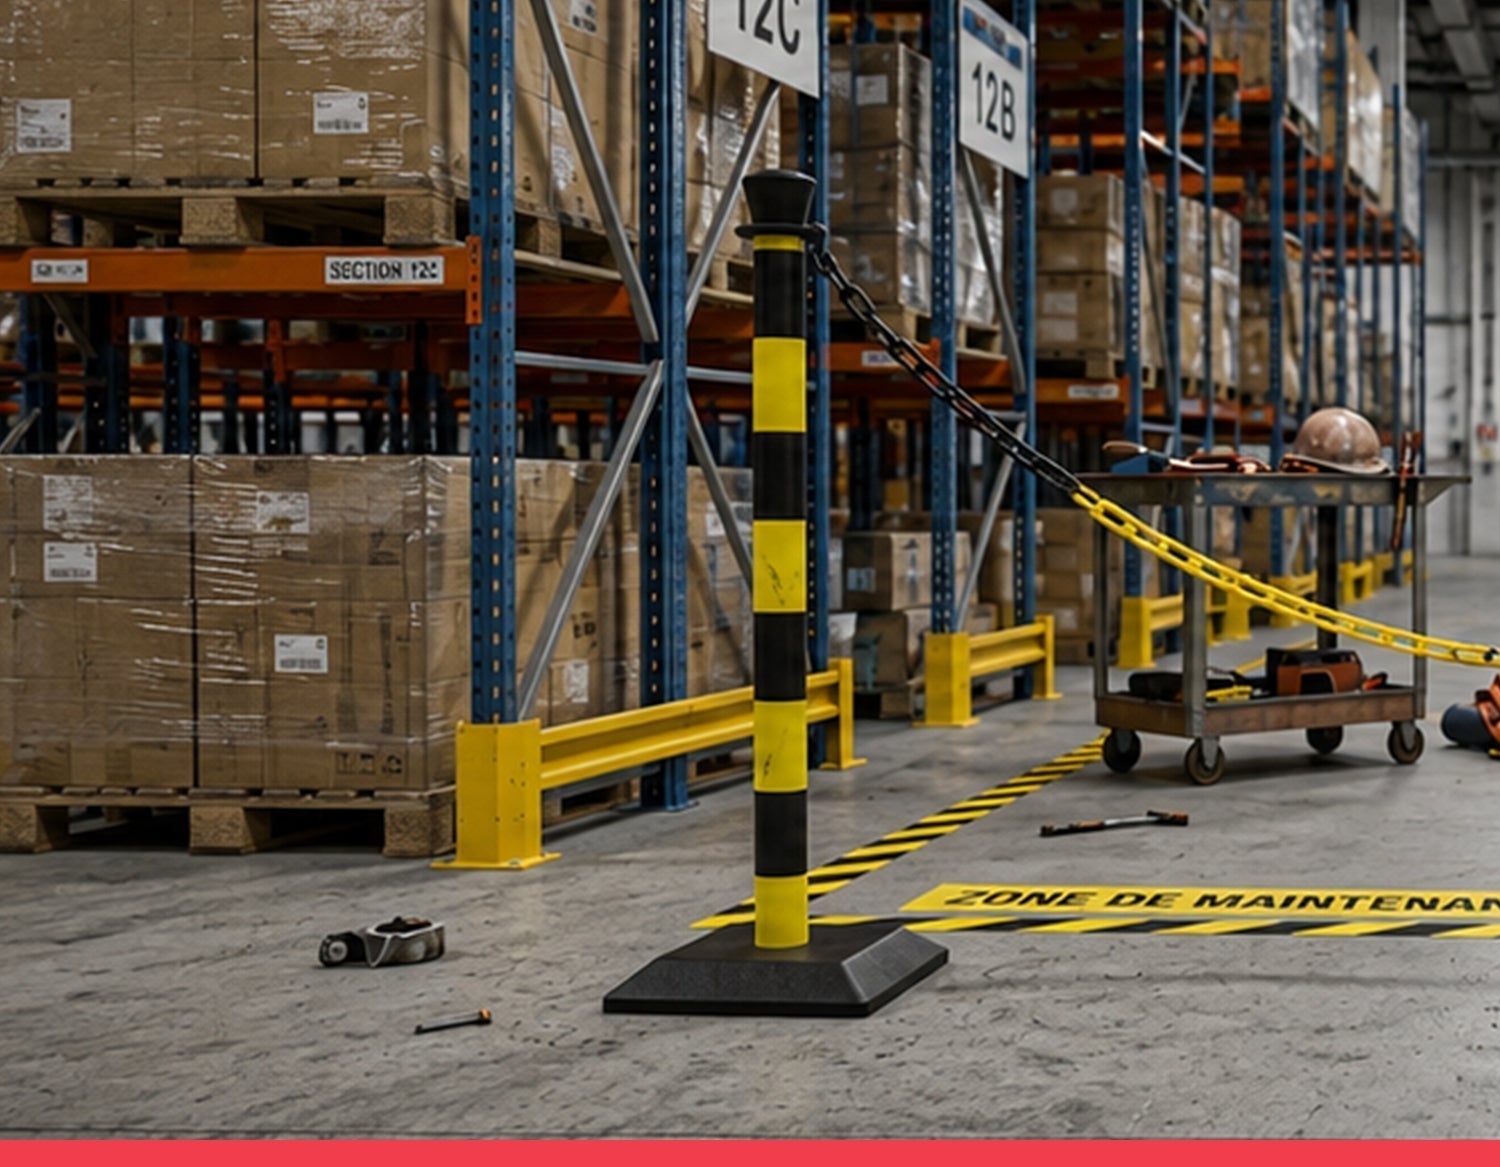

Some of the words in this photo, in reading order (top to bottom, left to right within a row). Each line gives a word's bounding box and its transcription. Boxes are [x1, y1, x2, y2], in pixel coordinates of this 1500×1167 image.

[972, 61, 1015, 142] 12B
[329, 261, 402, 279] SECTION
[944, 890, 1098, 906] ZONE
[1104, 892, 1183, 908] DE
